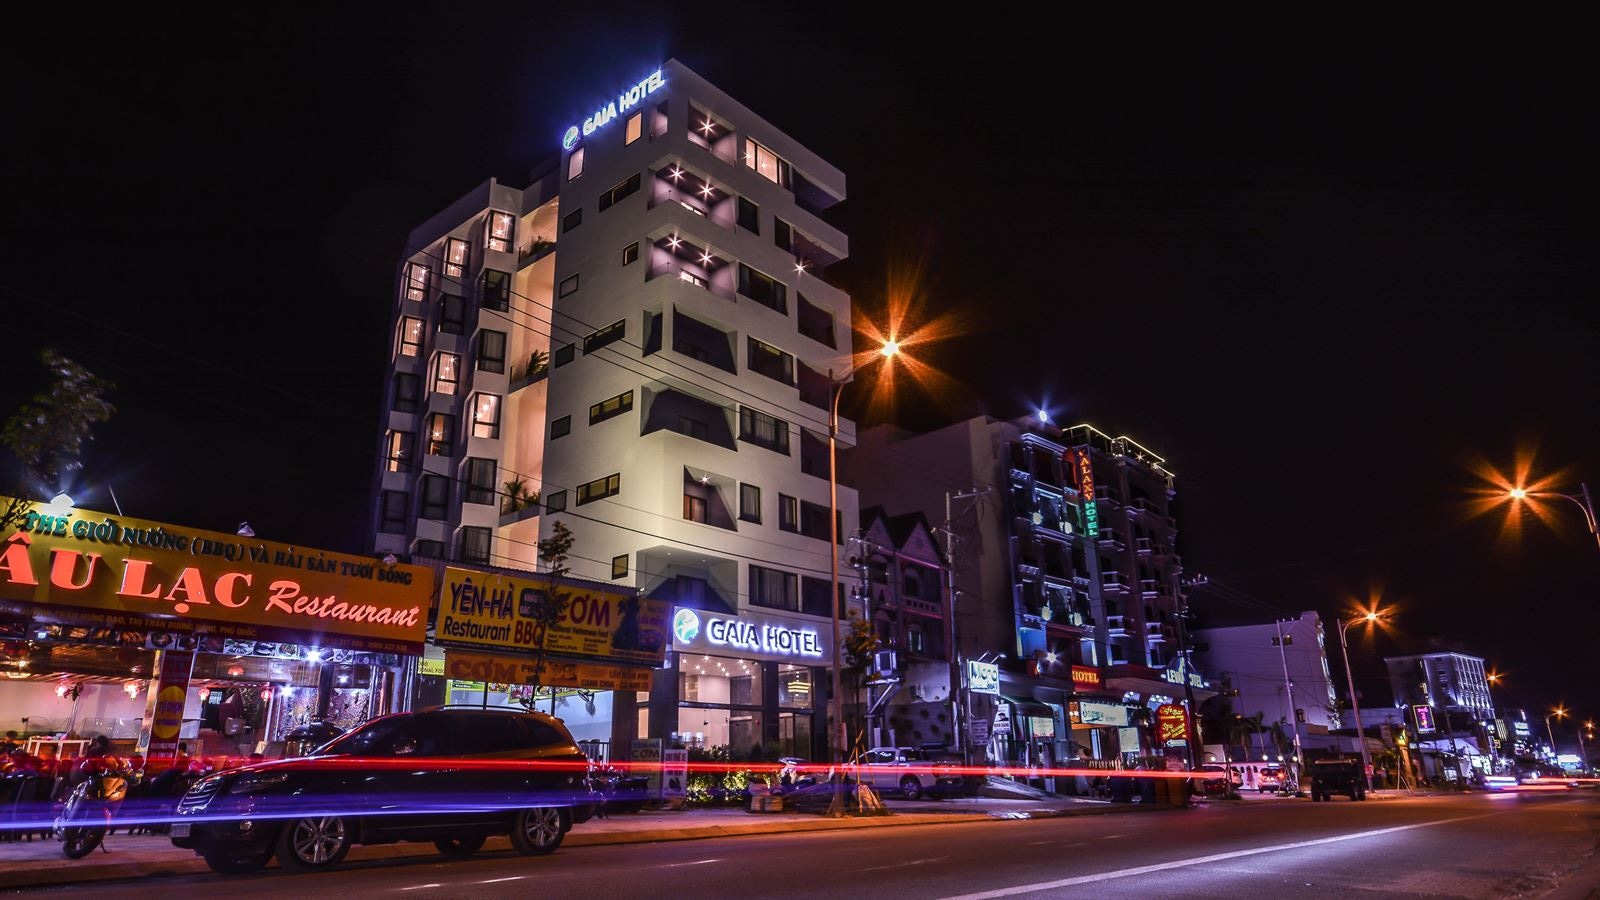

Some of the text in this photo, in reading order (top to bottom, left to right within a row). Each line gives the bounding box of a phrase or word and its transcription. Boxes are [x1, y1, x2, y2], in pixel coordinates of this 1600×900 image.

[583, 70, 665, 136] GAIA HOTEL
[1085, 502, 1098, 536] HOTEL
[73, 517, 119, 543] GIỚI
[122, 526, 188, 551] NƯỚNG
[248, 543, 269, 563] VÀ
[274, 545, 303, 569] HẢI
[307, 553, 338, 575] SẢN
[341, 561, 374, 580] TƯƠI
[378, 565, 413, 585] SỐNG
[116, 558, 253, 614] LẠC
[264, 580, 420, 627] Restaurant
[450, 576, 515, 620] YÊN-HÀ
[443, 615, 512, 642] Restaurant
[514, 620, 544, 646] BBQ
[707, 617, 822, 656] GAIA HOTEL
[449, 659, 517, 684] CƠM
